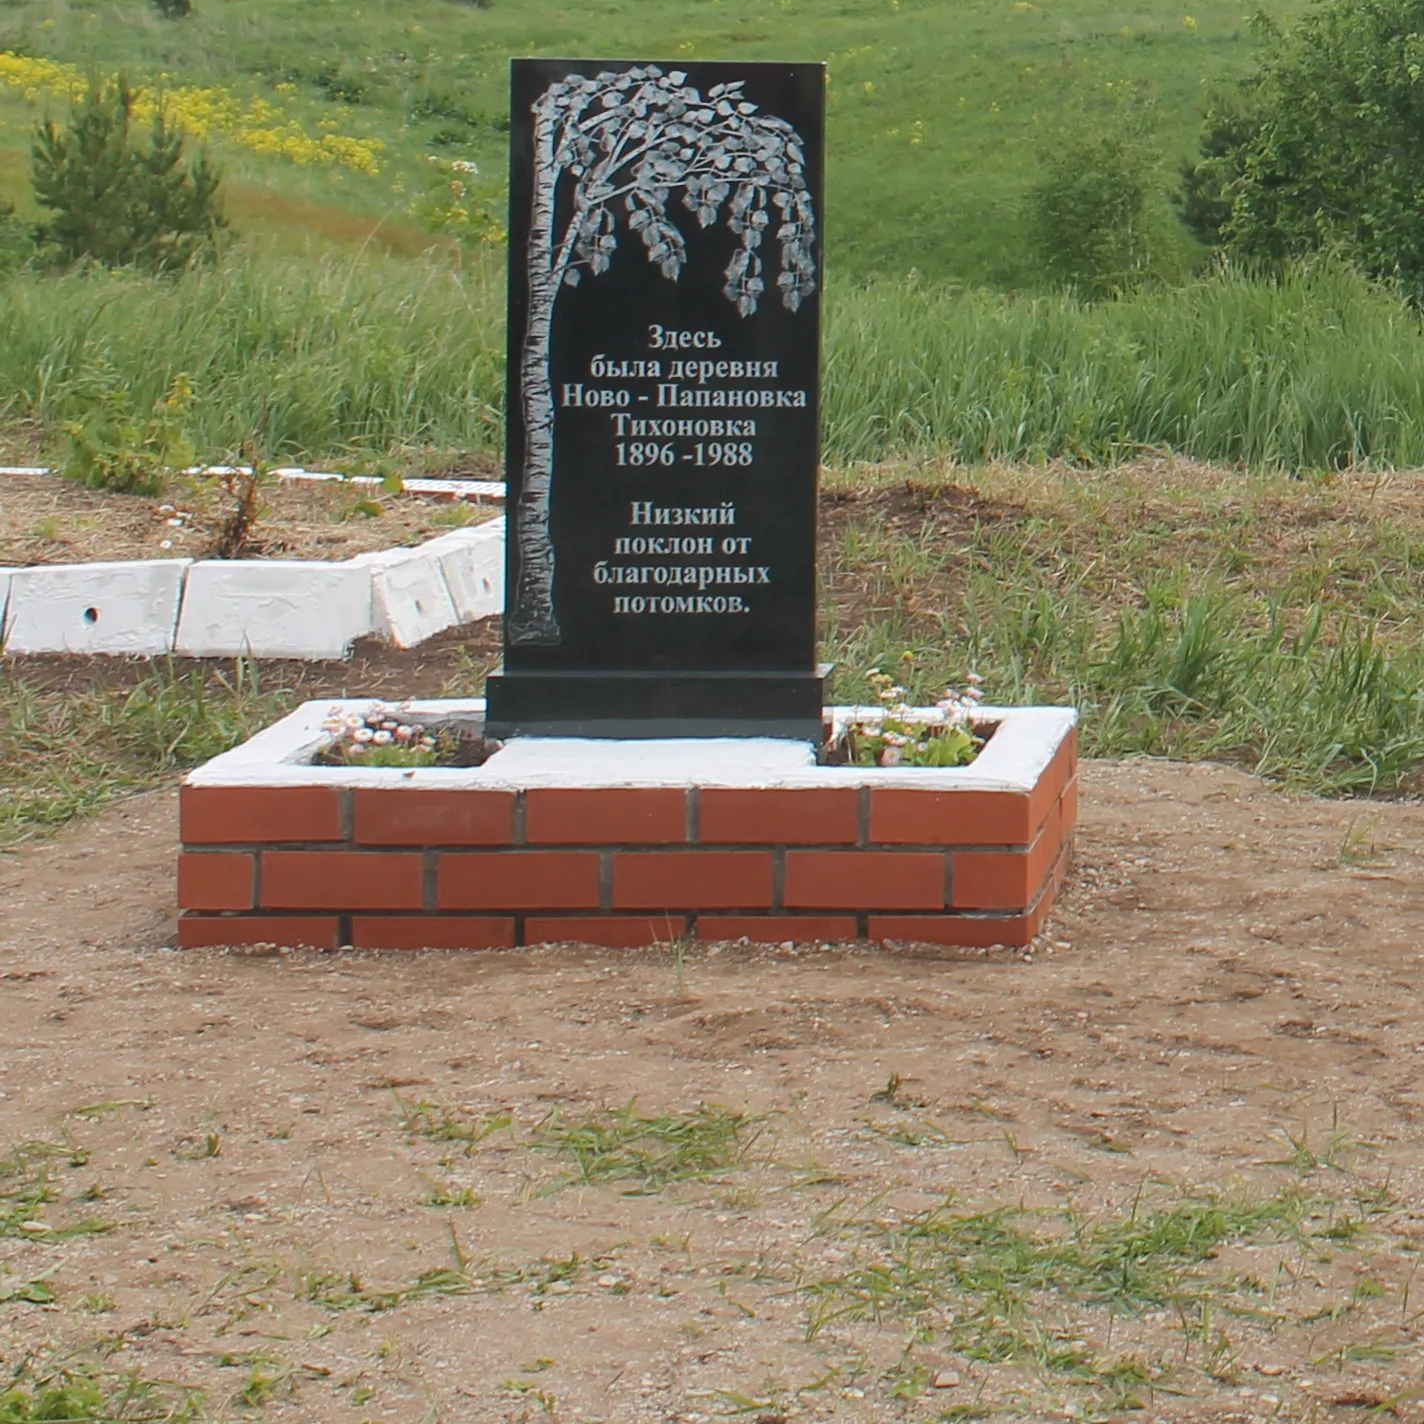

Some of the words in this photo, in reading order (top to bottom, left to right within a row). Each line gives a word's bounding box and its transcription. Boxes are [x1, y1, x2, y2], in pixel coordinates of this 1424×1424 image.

[649, 325, 721, 350] Здесь
[591, 354, 661, 377] была
[668, 361, 777, 384] деревня
[562, 384, 630, 407] Ново
[657, 384, 806, 407] Папановка
[611, 413, 756, 436] Тихоновка
[631, 502, 735, 525] Низкий
[615, 538, 713, 554] поклон
[722, 538, 751, 554] от
[594, 561, 770, 590] благодарных
[614, 596, 750, 613] потомков.
